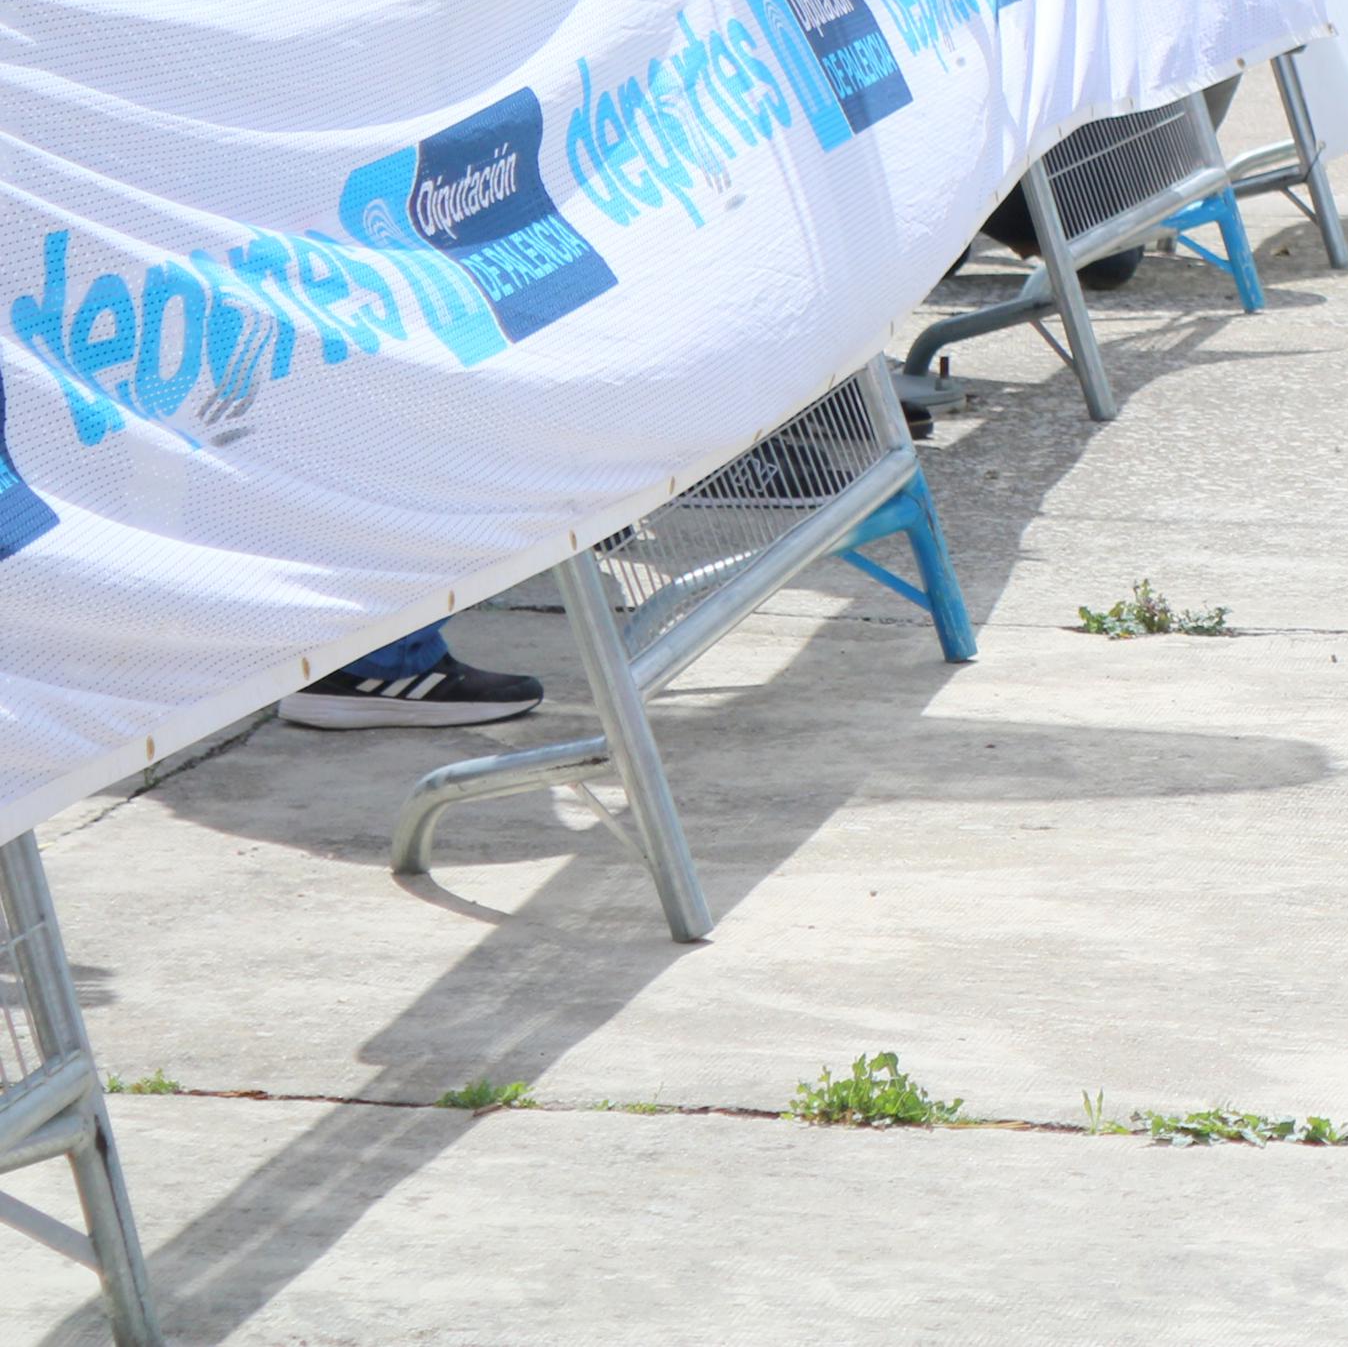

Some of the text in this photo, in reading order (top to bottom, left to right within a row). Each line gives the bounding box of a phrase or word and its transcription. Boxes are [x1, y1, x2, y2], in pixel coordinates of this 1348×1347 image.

[565, 10, 793, 230] deportes
[416, 142, 517, 240] Diputación
[459, 214, 592, 302] DE PALENCIA
